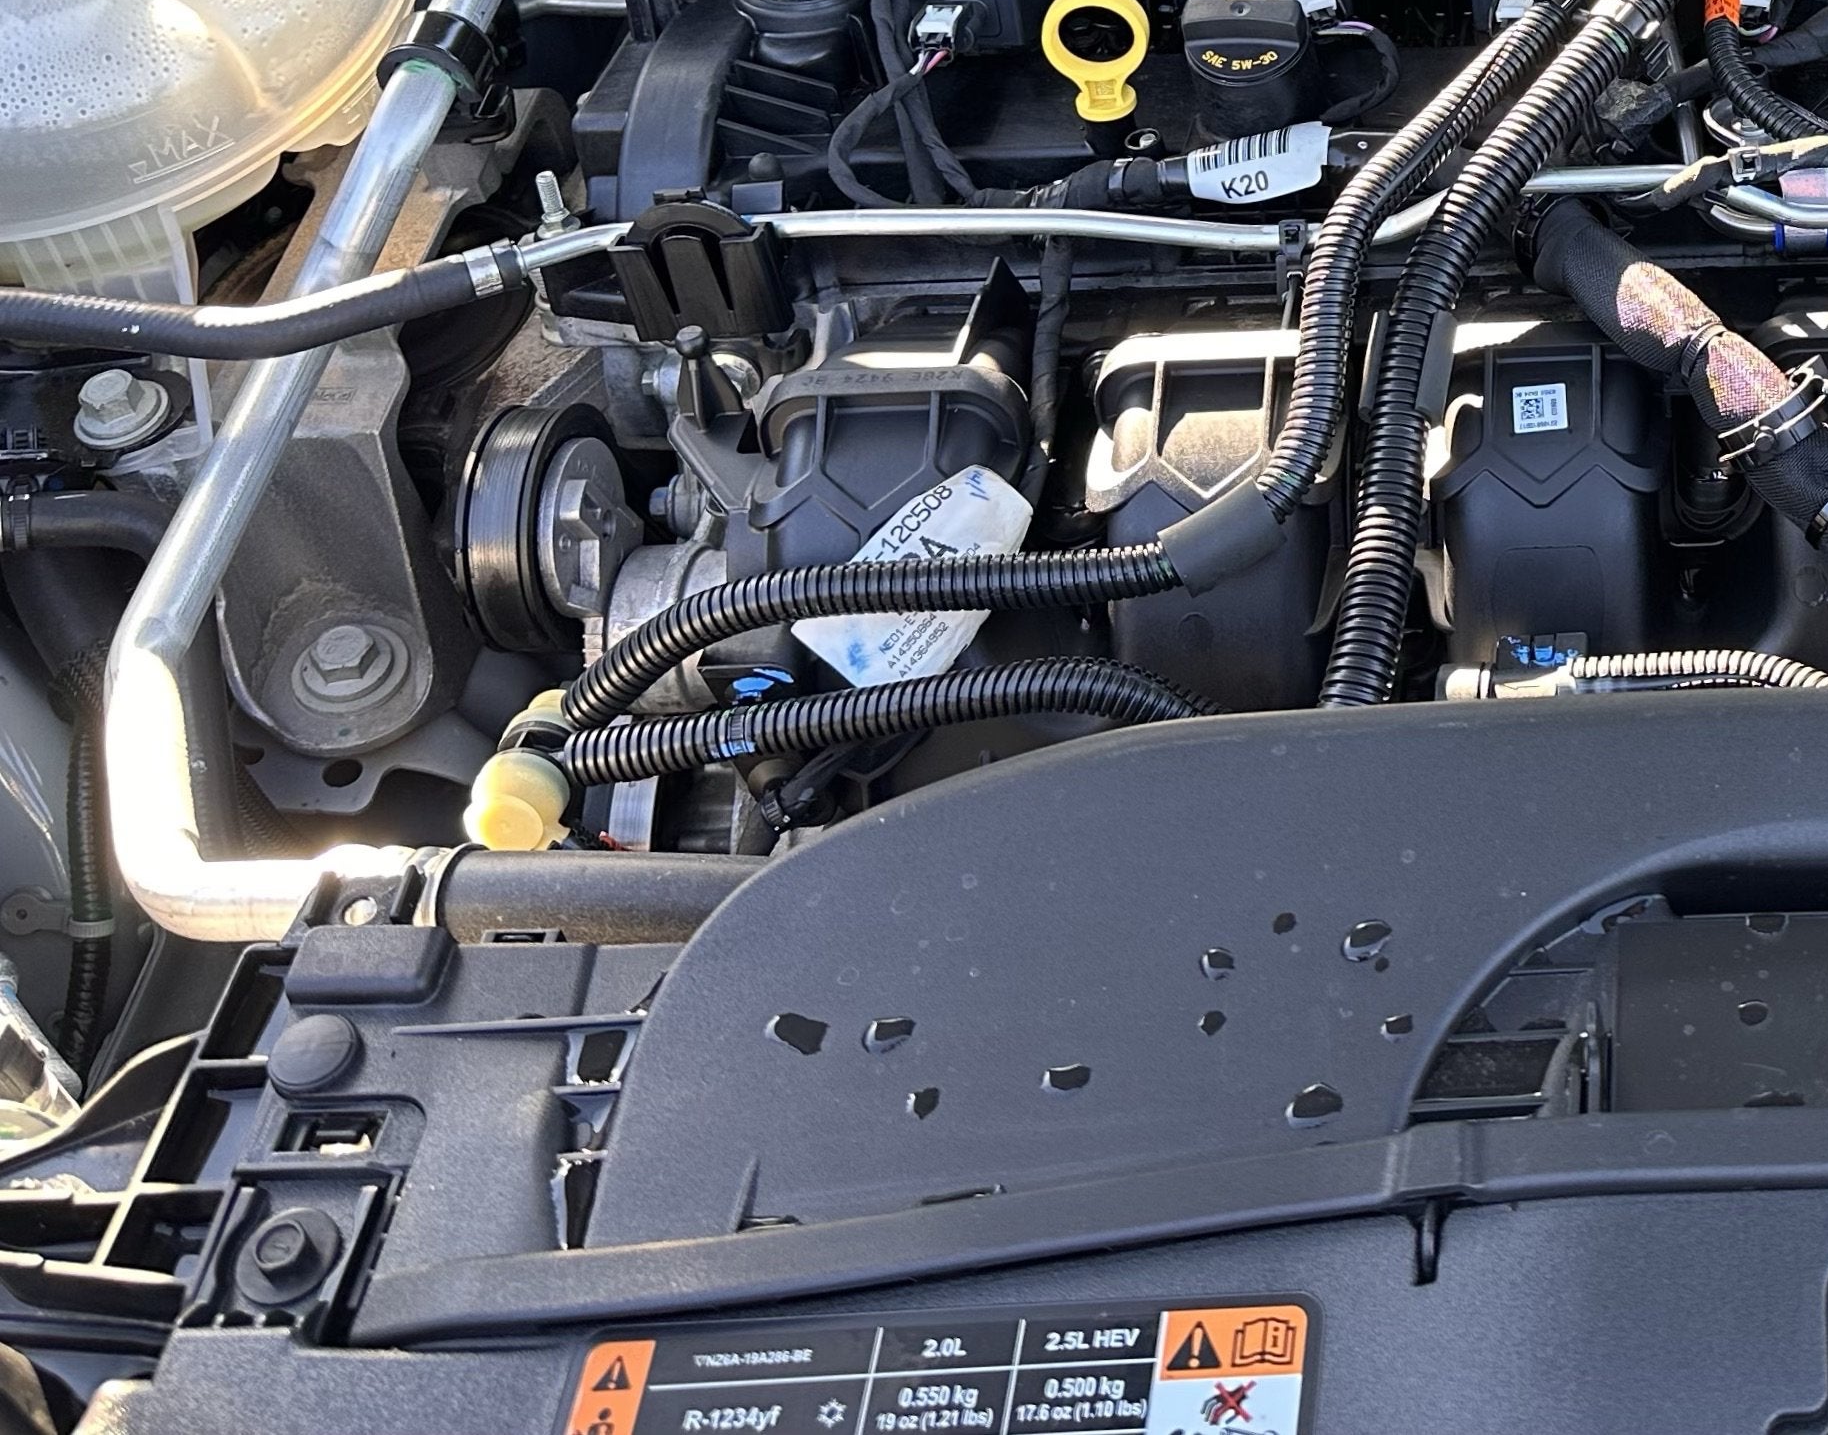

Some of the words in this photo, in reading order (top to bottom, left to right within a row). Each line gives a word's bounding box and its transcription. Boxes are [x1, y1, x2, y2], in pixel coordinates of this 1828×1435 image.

[1201, 50, 1227, 68] SAE
[1231, 51, 1278, 71] 5W-30
[148, 116, 231, 164] MAX
[1221, 170, 1269, 200] K20
[922, 1338, 967, 1358] 2.0L
[1044, 1331, 1089, 1351] 2.5L
[1092, 1328, 1140, 1348] HEV
[898, 1386, 950, 1407] 0.550
[953, 1385, 979, 1408] kg
[1044, 1379, 1096, 1400] 0.500
[1098, 1376, 1125, 1401] kg
[682, 1404, 782, 1432] R-1234yf
[876, 1413, 895, 1432] 19
[898, 1415, 918, 1429] oz
[963, 1408, 995, 1428] lbs)
[1016, 1404, 1050, 1422] 17.6
[1051, 1406, 1072, 1421] oz
[1116, 1398, 1148, 1420] lbs)
